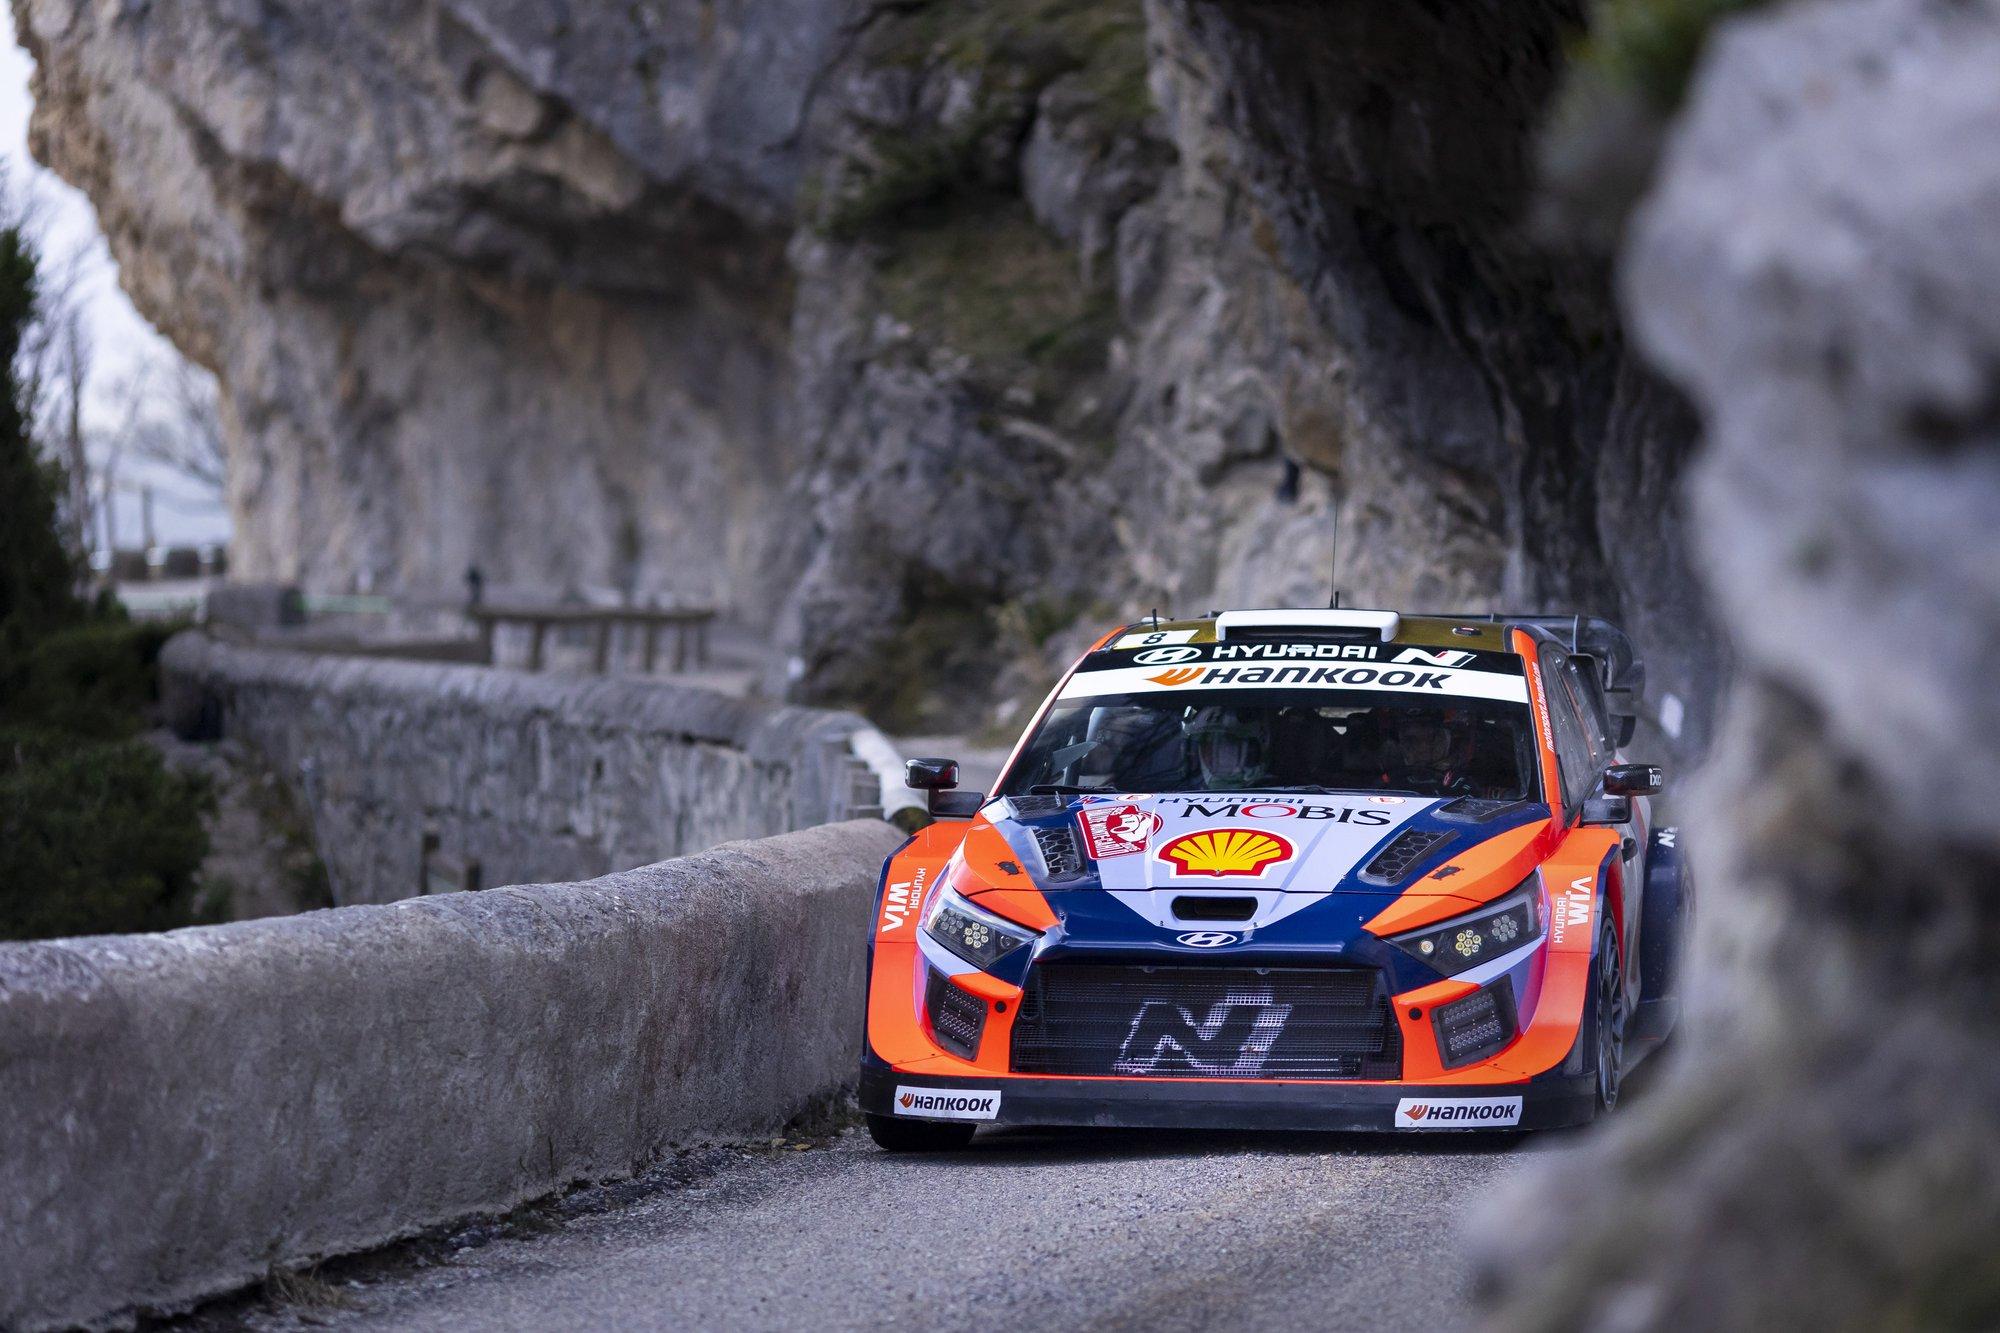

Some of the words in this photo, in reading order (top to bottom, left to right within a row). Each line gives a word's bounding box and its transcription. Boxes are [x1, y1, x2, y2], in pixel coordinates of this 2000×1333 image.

[1141, 632, 1168, 645] 8
[1212, 644, 1378, 659] HYUNDAI
[1180, 803, 1391, 826] MOBIS
[909, 867, 927, 909] HYUNDAI
[1553, 897, 1567, 944] HYUNDAI
